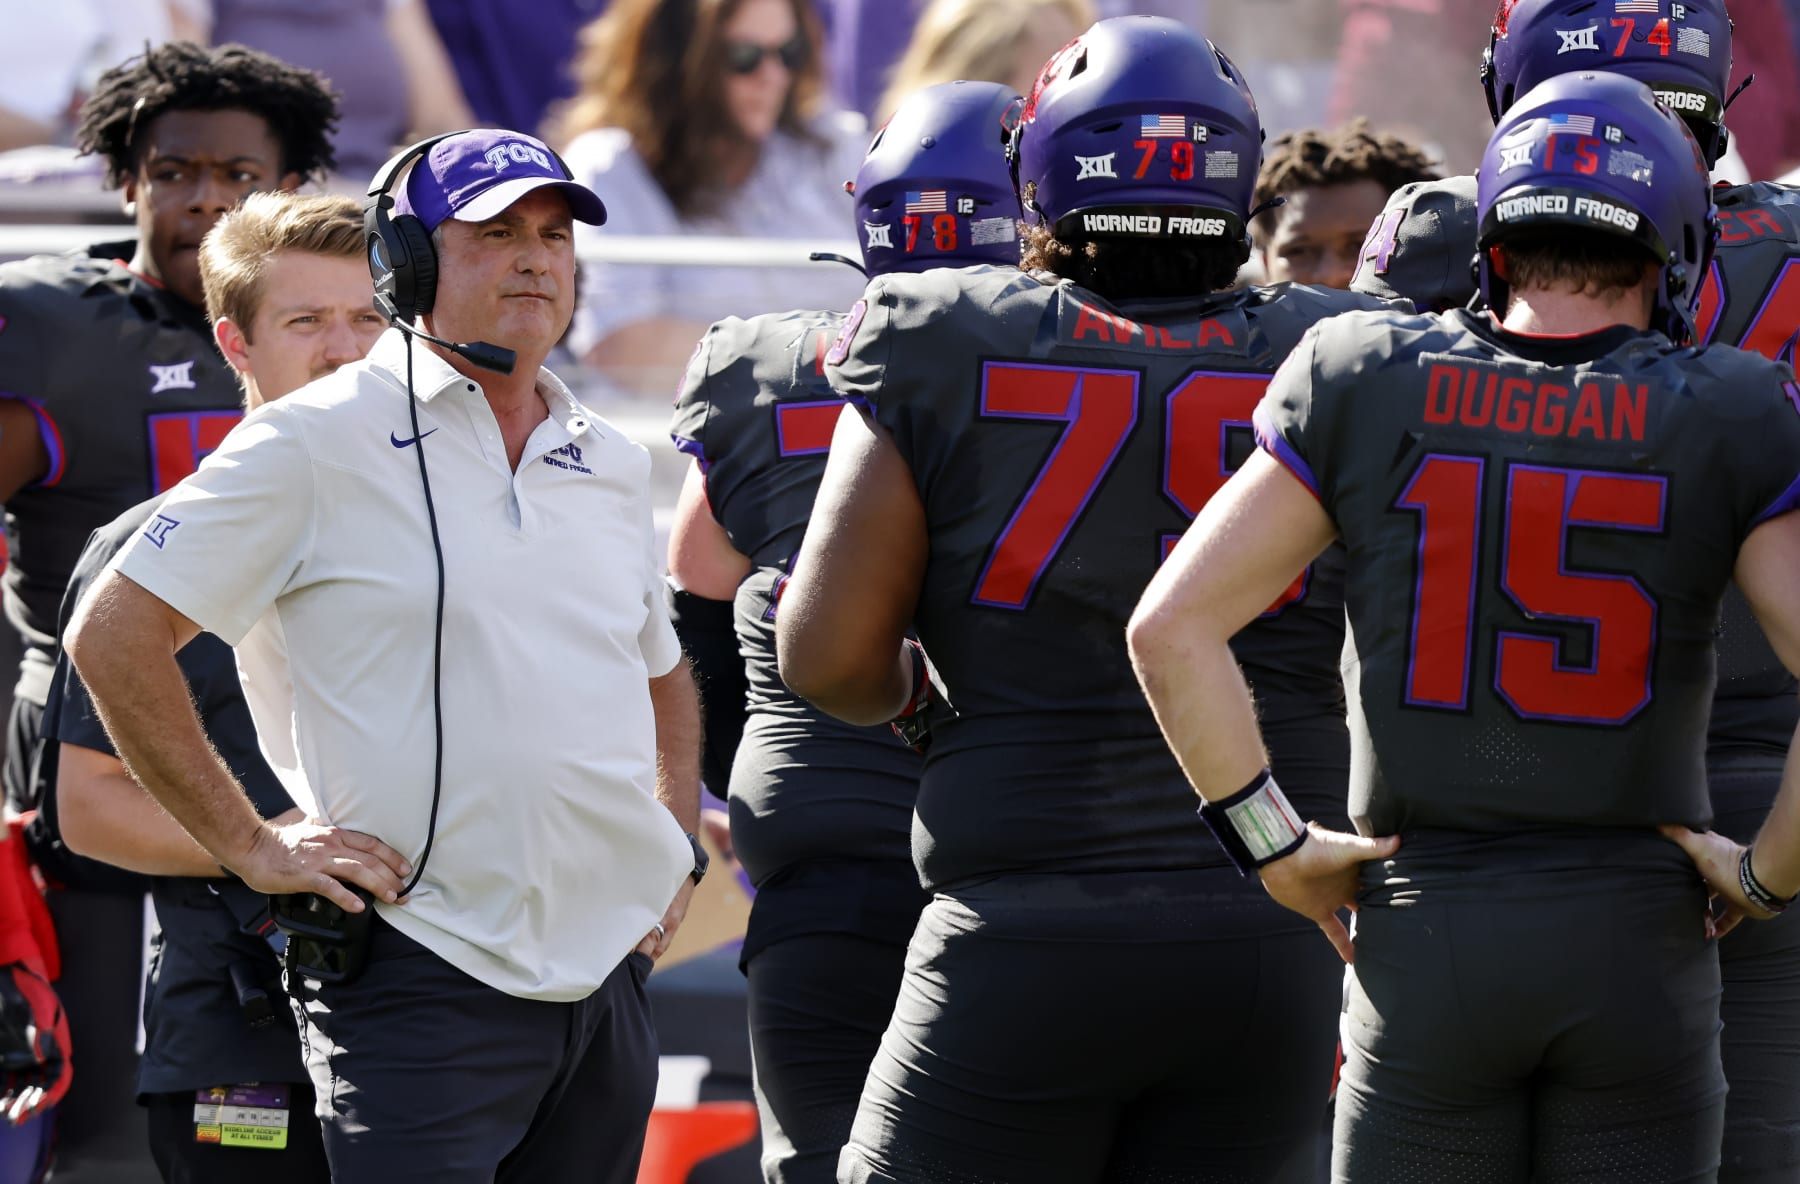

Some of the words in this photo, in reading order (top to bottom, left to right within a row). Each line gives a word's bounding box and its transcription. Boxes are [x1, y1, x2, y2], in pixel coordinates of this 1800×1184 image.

[1671, 3, 1685, 19] 12
[1193, 125, 1207, 141] 12
[1605, 126, 1622, 143] 12
[484, 143, 553, 173] TCU
[957, 198, 974, 214] 12
[1496, 196, 1568, 222] HORNED
[1574, 197, 1640, 231] FROGS
[1083, 214, 1162, 233] HORNED
[1167, 217, 1226, 236] FROGS
[1072, 301, 1235, 349] AVILA
[1422, 365, 1649, 441] DUGGAN
[1396, 451, 1669, 726] 15
